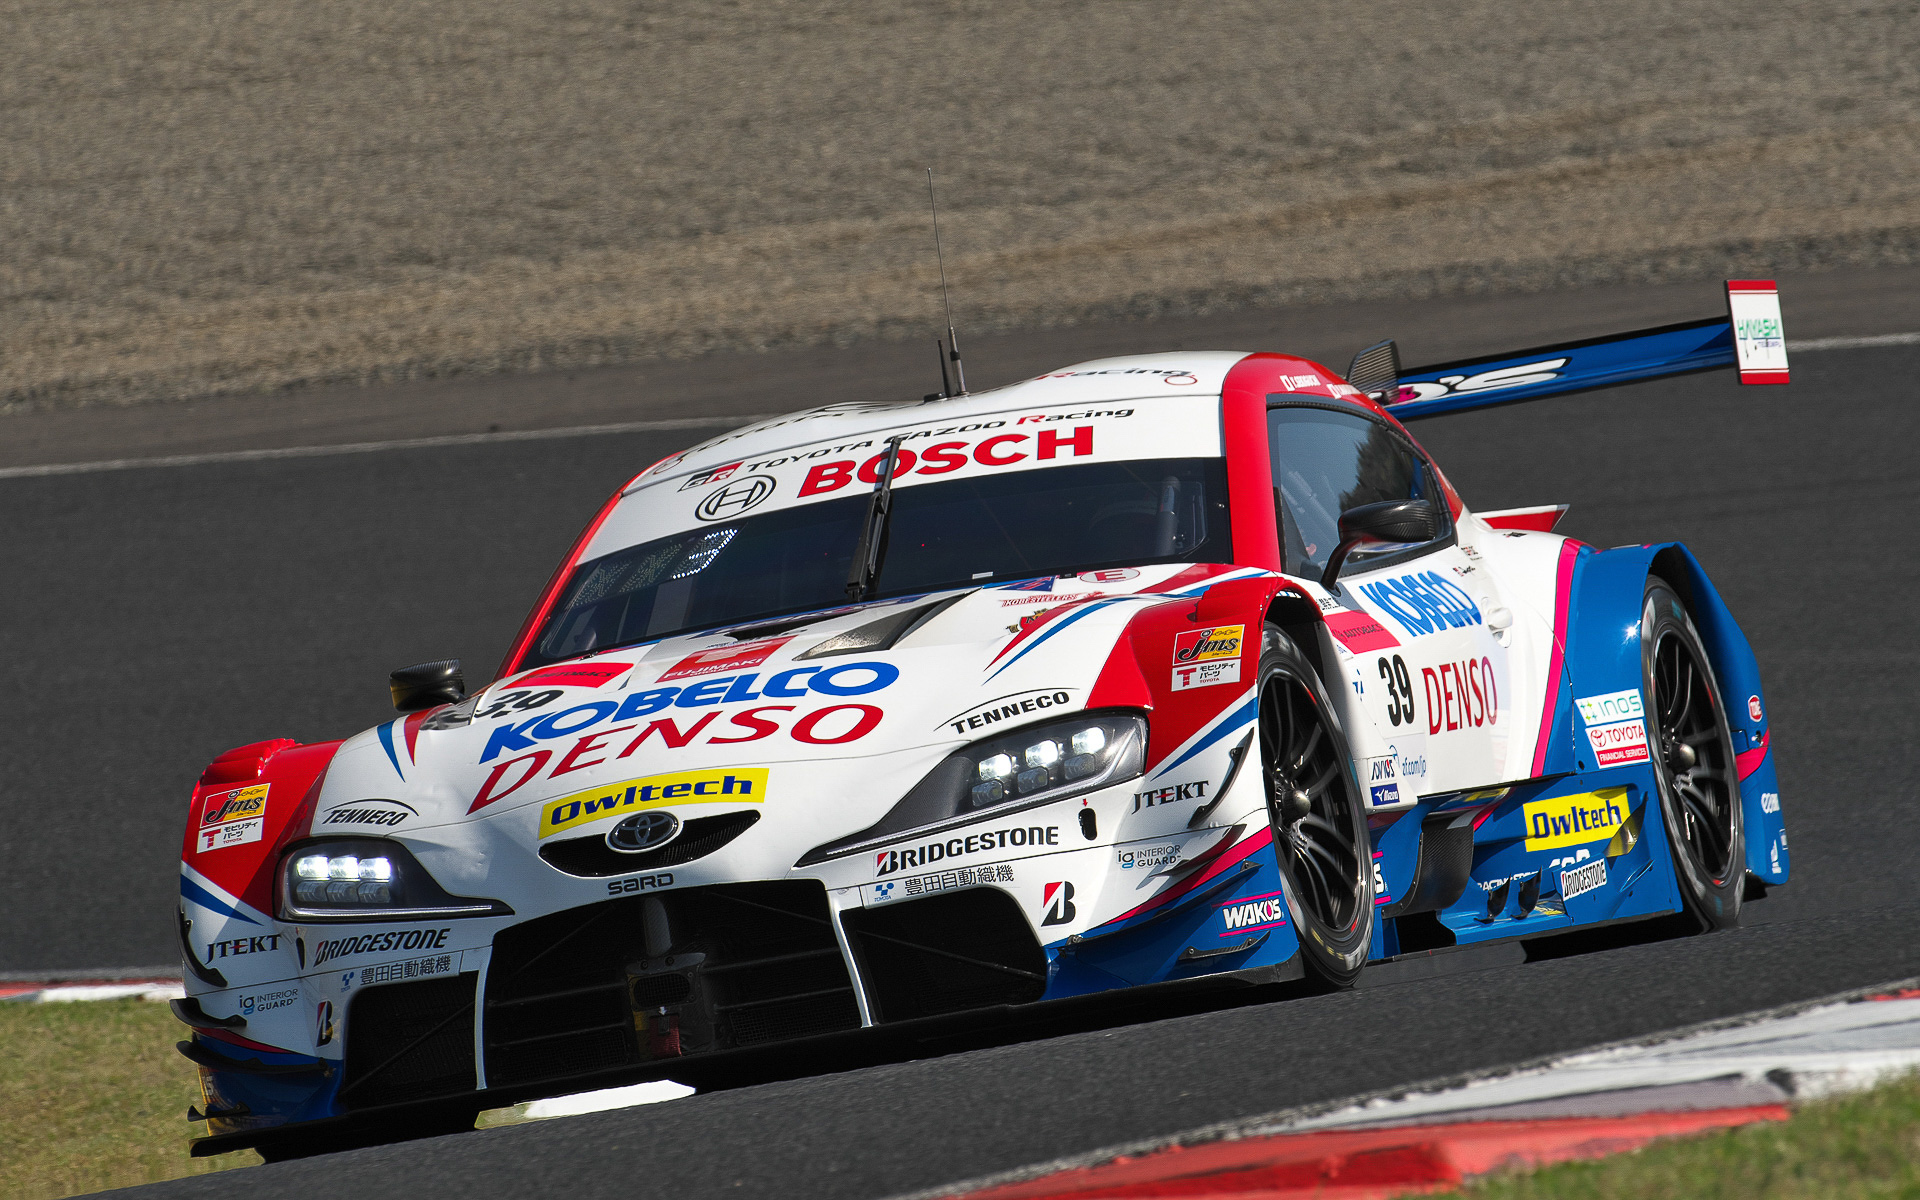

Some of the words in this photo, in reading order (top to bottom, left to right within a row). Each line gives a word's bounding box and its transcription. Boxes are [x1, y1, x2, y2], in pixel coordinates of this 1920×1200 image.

[747, 440, 873, 472] TOYOTA
[883, 420, 1007, 444] GAZOO
[1016, 407, 1136, 426] Racing
[797, 425, 1094, 498] BOSCH
[1359, 570, 1482, 637] KOBELCO
[1343, 624, 1384, 638] AUTOBACS
[663, 658, 762, 679] FUJIMAKI
[1200, 663, 1236, 671] モビリティ
[1200, 670, 1220, 679] パーツ
[1378, 654, 1414, 726] 39
[1421, 656, 1497, 735] DENSO
[479, 661, 899, 764] KOBELCO
[950, 691, 1070, 734] TENNECO
[1606, 725, 1645, 742] TOYOTA
[465, 704, 884, 816] DENSO
[1599, 750, 1625, 761] FINANCIAL
[1625, 747, 1647, 758] SERVICES
[551, 776, 752, 825] Owltech
[1131, 781, 1209, 815] JTEKT
[224, 821, 258, 832] モビリティ
[322, 808, 409, 826] TENNECO
[1532, 799, 1622, 840] Owltech
[223, 830, 243, 840] パーツ
[1137, 844, 1181, 858] INTERIOR
[876, 826, 1059, 877] BRIDGESTONE
[607, 873, 674, 895] SARD
[905, 864, 1014, 896] 豊田自動織機
[1562, 862, 1606, 897] BRIDGESTONE
[205, 934, 282, 965] JTEKT
[313, 928, 451, 968] BRIDGESTONE
[360, 955, 451, 986] 豊田自動織機
[256, 988, 298, 1002] INTERIOR
